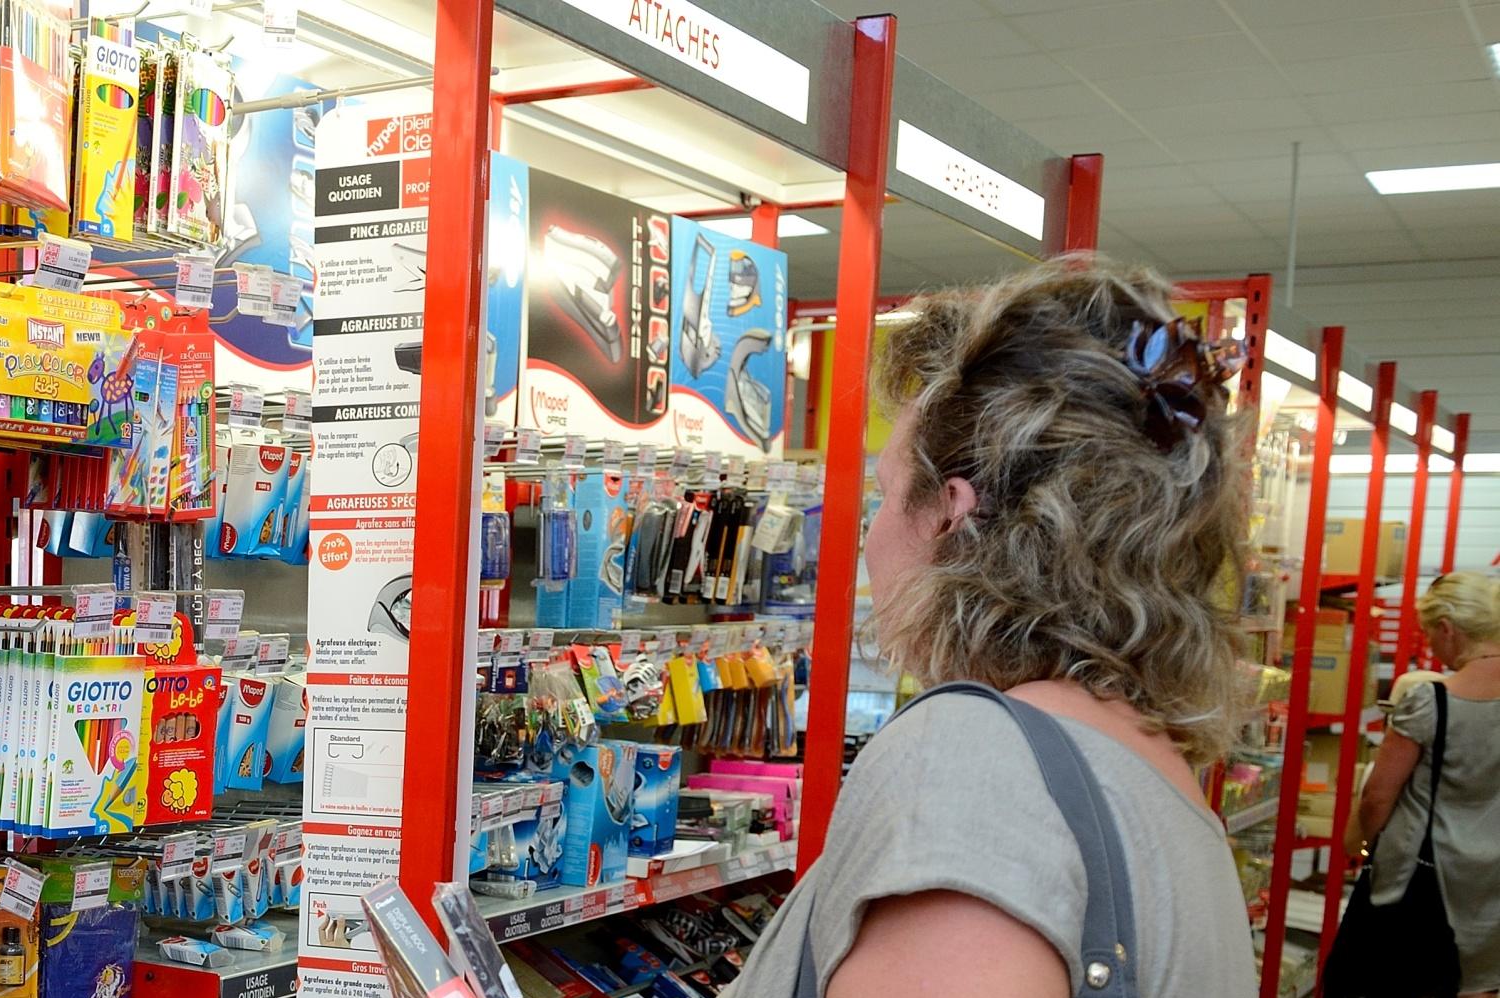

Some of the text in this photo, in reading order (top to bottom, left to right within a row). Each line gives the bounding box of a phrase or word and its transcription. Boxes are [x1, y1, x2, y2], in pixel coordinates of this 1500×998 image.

[628, 0, 721, 70] ATTACHES
[97, 46, 136, 72] GIOTTO
[367, 117, 400, 156] hyper
[339, 174, 371, 187] USAGE
[329, 187, 382, 202] QUOTIDIEN
[351, 220, 427, 238] PINCE AGRAFEU
[341, 317, 397, 332] AGRAFEUSE
[401, 316, 412, 328] DE
[28, 322, 65, 345] INSTANT
[76, 333, 100, 342] NEW!!
[319, 368, 330, 376] pour
[332, 367, 352, 375] quelques
[33, 377, 59, 398] kids
[536, 390, 568, 412] Maped
[335, 406, 391, 420] AGRAFEUSE
[547, 416, 567, 427] OFFICE
[29, 425, 49, 433] AND
[55, 428, 86, 438] PAINT
[121, 424, 131, 438] 12
[262, 451, 283, 461] Maped
[327, 498, 388, 509] AGRAFEUSES
[356, 519, 383, 529] Agrafez
[323, 538, 345, 547] -70%
[322, 552, 348, 563] Effort
[316, 639, 376, 648] Agrafeuse électrique
[68, 681, 132, 702] GIOTTO
[243, 684, 264, 696] Maped
[170, 688, 203, 709] be-bè
[348, 826, 373, 837] Gagnez
[308, 843, 329, 851] Certaines
[331, 845, 356, 853] agrafeuses
[353, 880, 371, 888] parfaite
[545, 903, 561, 916] USAGE
[510, 912, 526, 925] USAGE
[393, 907, 427, 954] DISPLAY BOOK
[505, 922, 530, 938] QUOTIDIEN
[246, 974, 269, 990] USAGE
[304, 976, 385, 989] Agrafeuses de grande capacité
